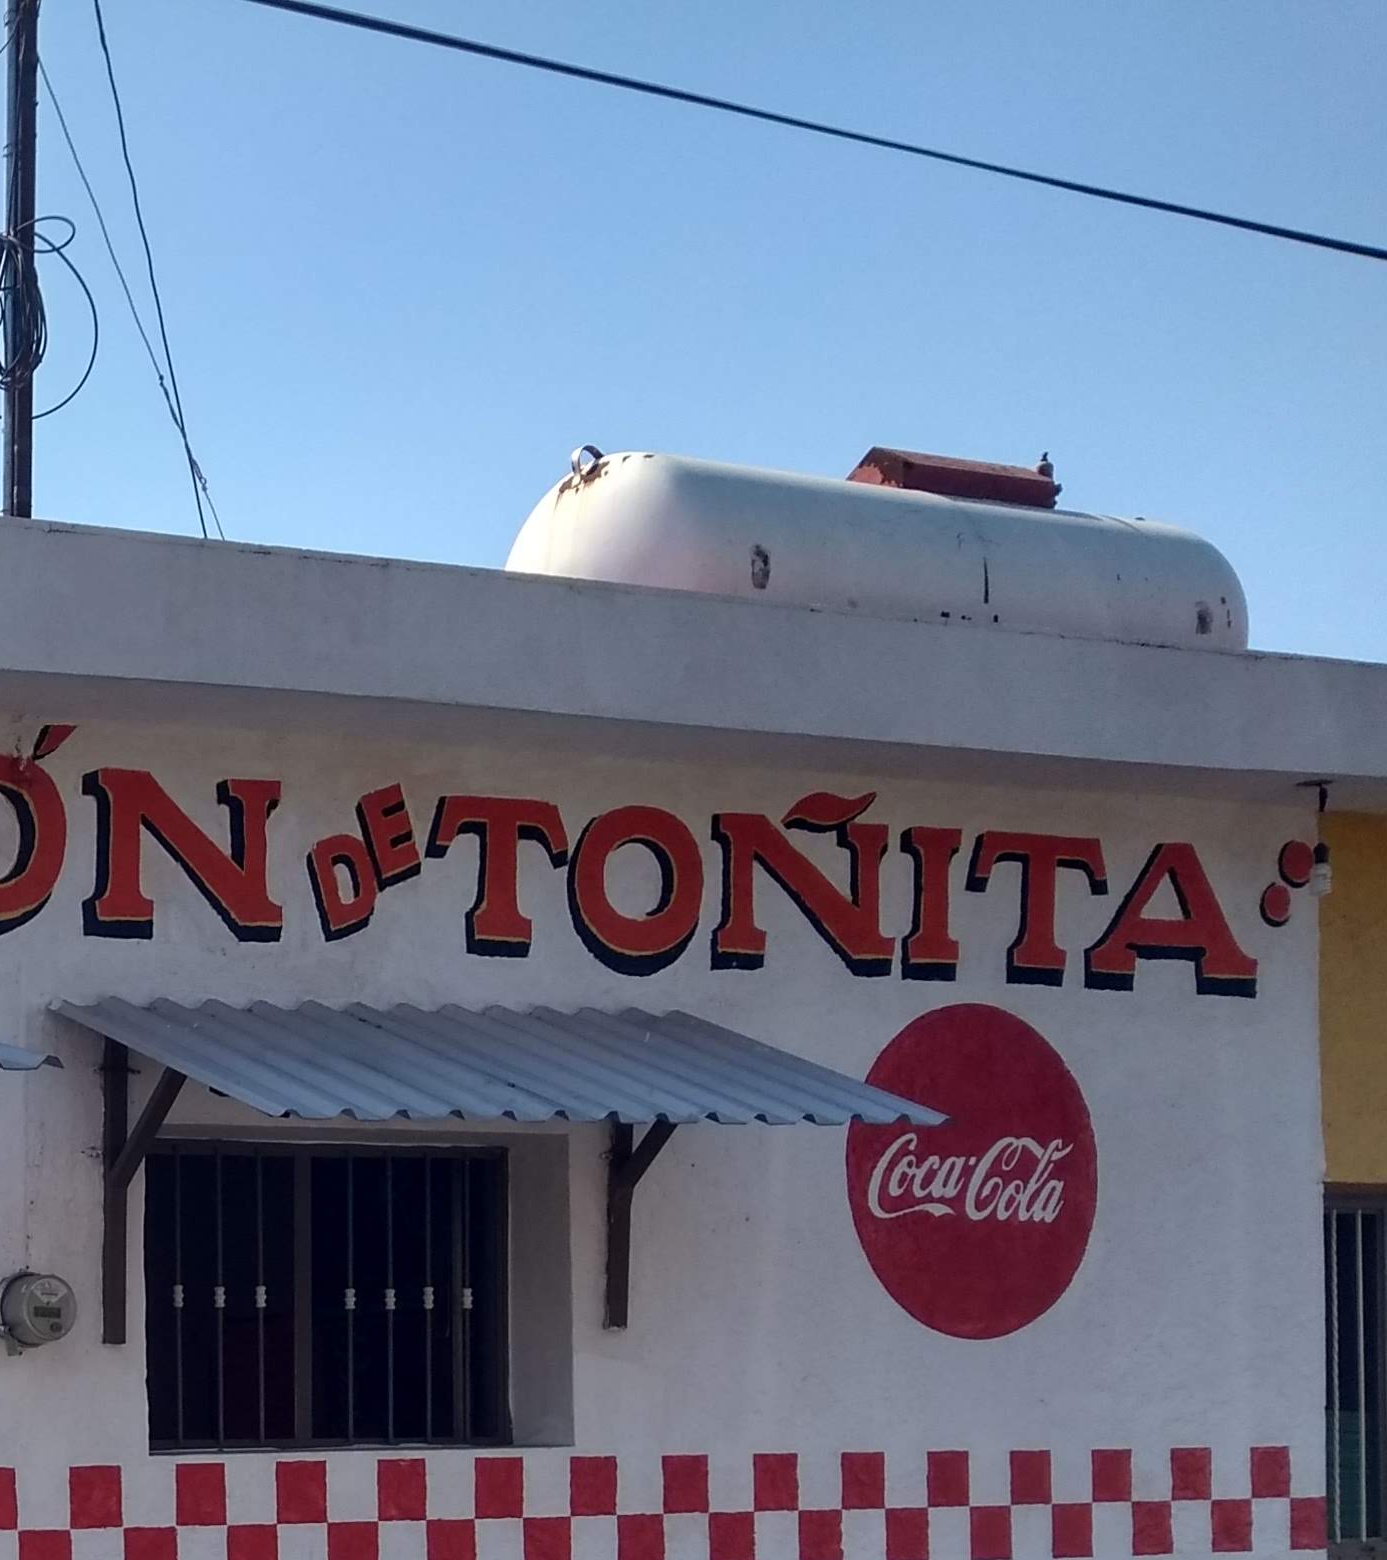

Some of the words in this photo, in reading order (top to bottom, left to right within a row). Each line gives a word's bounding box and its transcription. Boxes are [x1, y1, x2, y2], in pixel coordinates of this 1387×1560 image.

[307, 783, 422, 942] DE
[425, 790, 1258, 998] TOÑITA
[868, 1133, 1074, 1223] Coca-Cola
